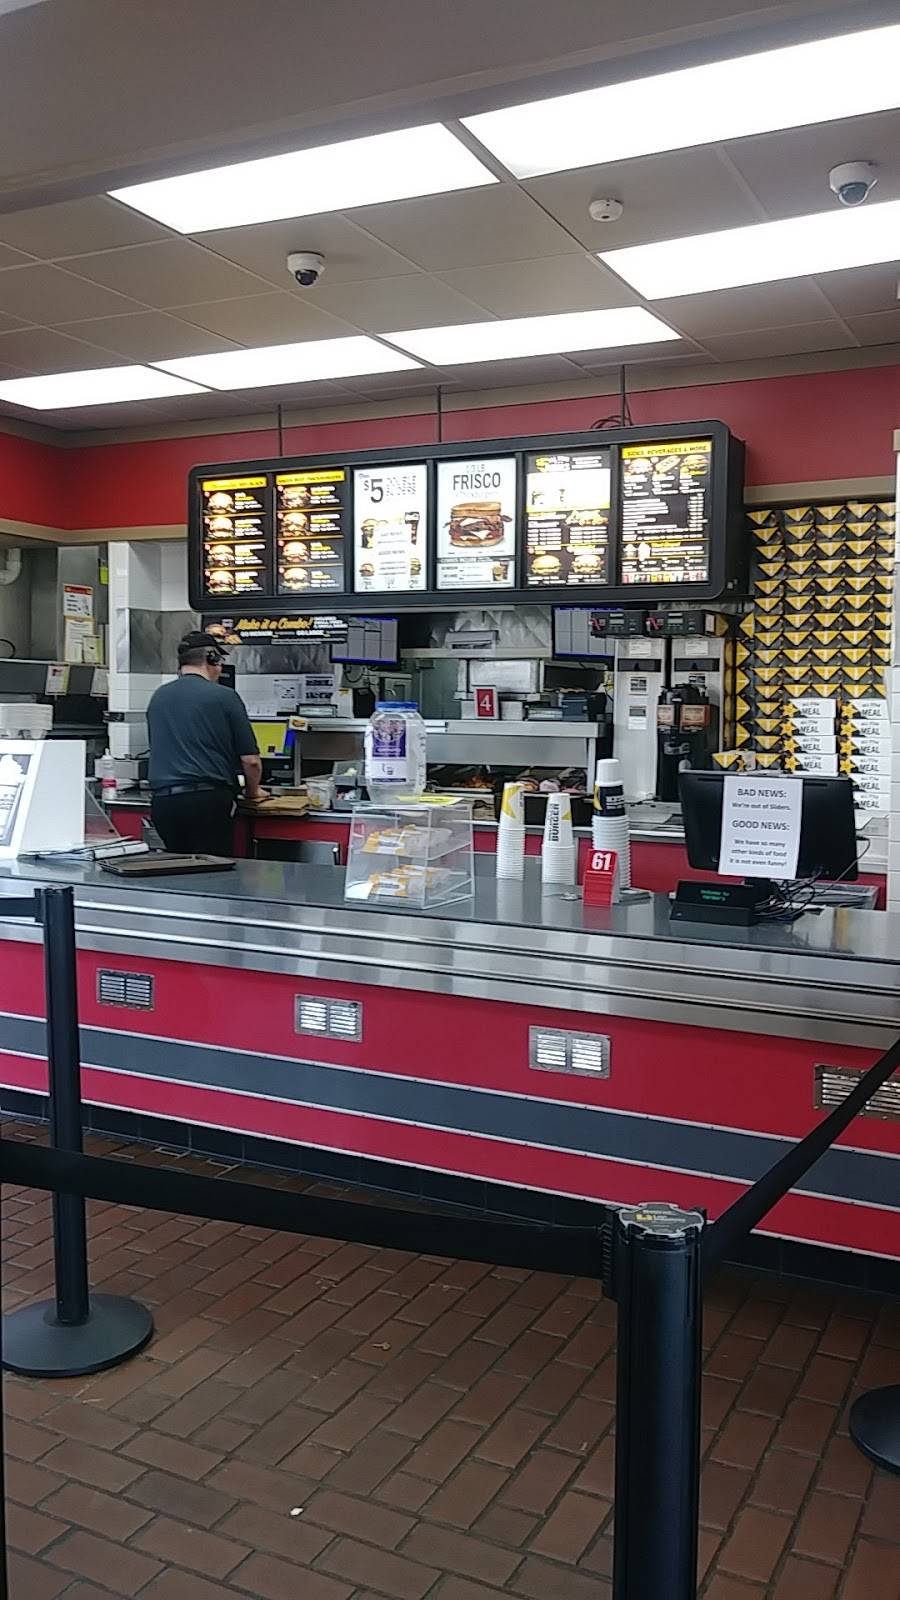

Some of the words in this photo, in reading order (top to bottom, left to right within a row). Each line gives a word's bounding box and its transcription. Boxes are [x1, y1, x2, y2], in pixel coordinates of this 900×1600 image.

[453, 472, 501, 491] FRISCO
[479, 694, 492, 711] 4
[802, 707, 821, 716] MEAL
[862, 708, 882, 717] MEAL
[800, 724, 820, 733] MEAL
[860, 727, 880, 736] MEAL
[802, 742, 821, 751] MEAL
[860, 745, 880, 754] MEAL
[803, 761, 822, 770] MEAL
[859, 763, 880, 772] MEAL
[860, 782, 880, 791] MEAL
[737, 788, 756, 796] BAD
[758, 789, 787, 798] NEWS:
[860, 800, 880, 809] MEAL
[551, 803, 560, 841] BURGER
[732, 820, 759, 829] GOOD
[760, 821, 790, 831] NEWS:
[591, 852, 612, 871] 61
